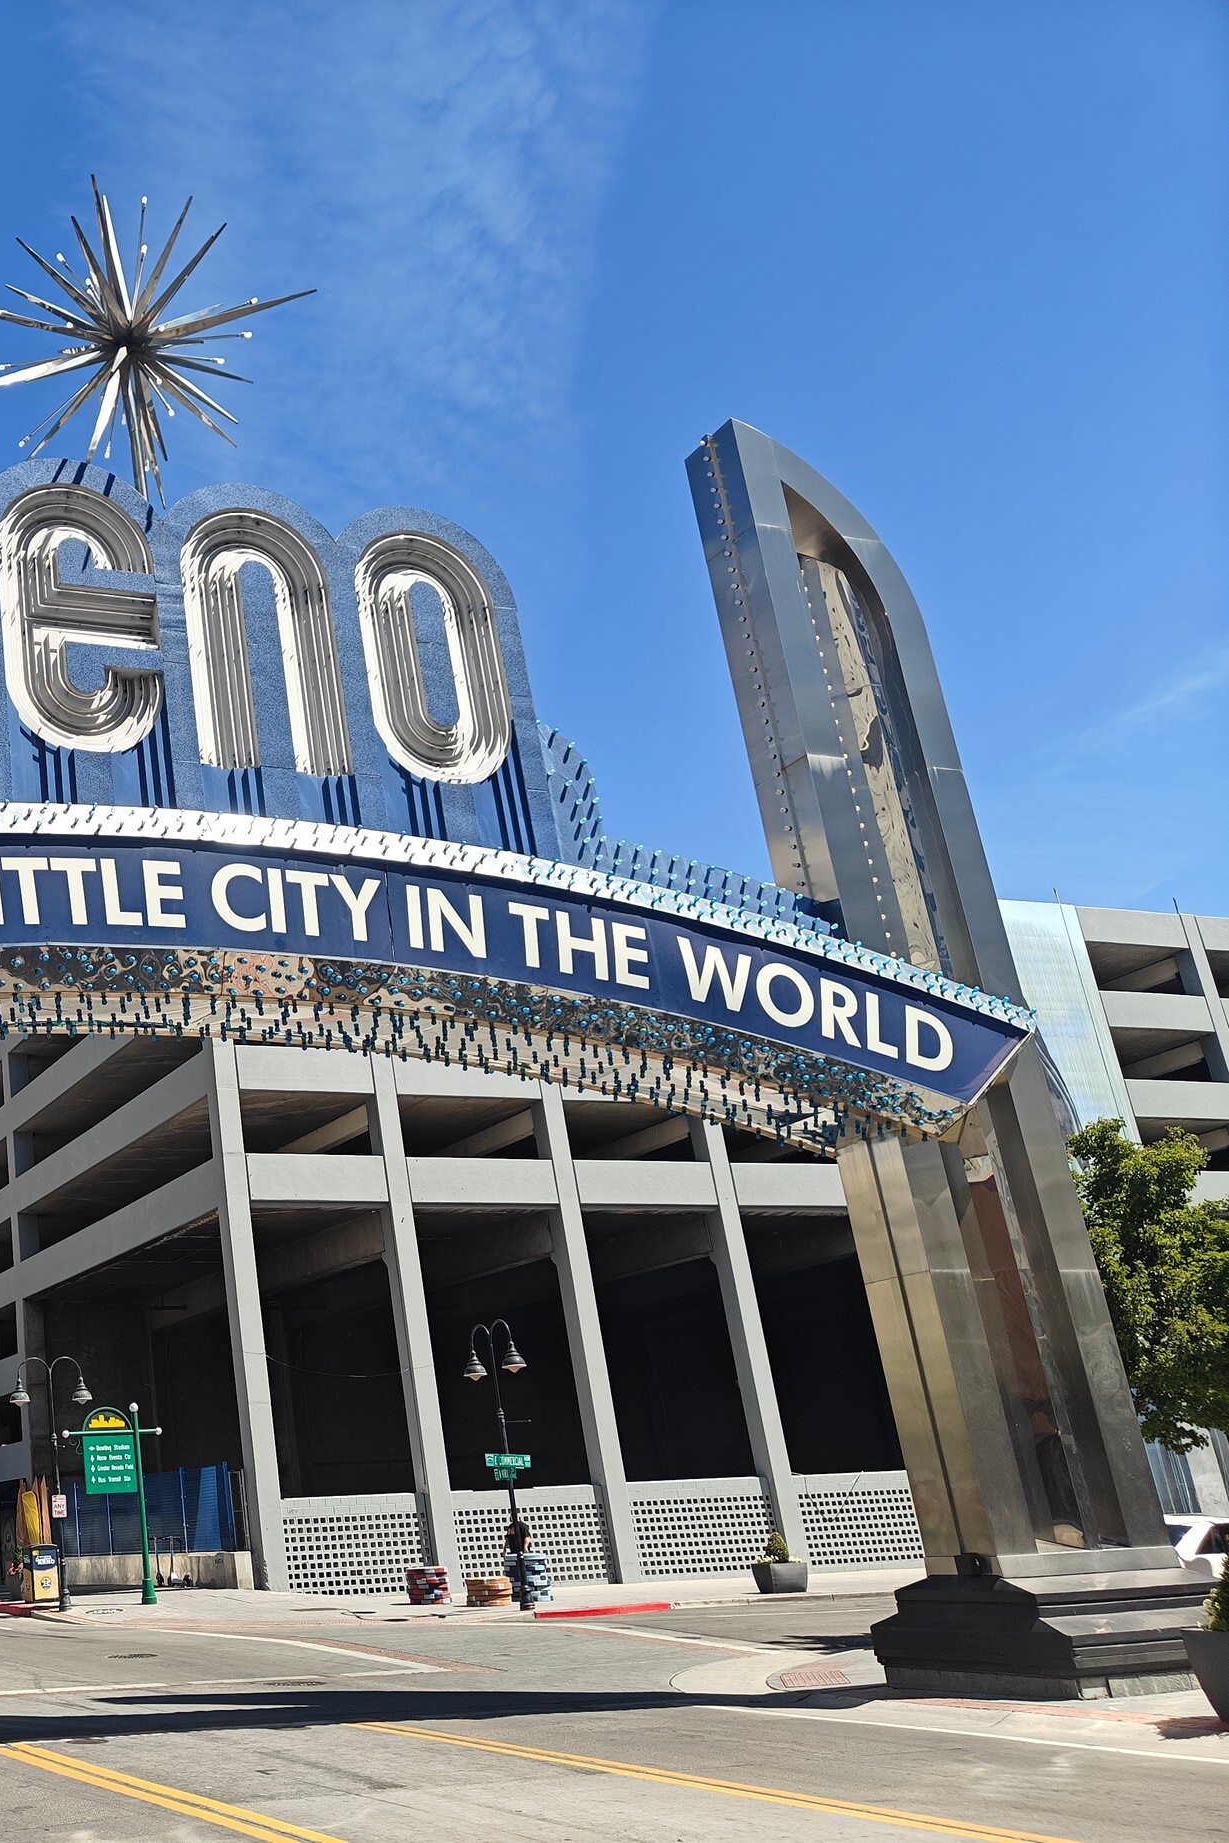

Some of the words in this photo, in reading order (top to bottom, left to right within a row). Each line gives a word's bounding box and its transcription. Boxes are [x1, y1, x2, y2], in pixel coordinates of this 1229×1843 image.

[211, 863, 382, 942] CITY
[405, 885, 487, 959] IN
[508, 901, 650, 990] THE
[676, 935, 954, 1072] WORLD
